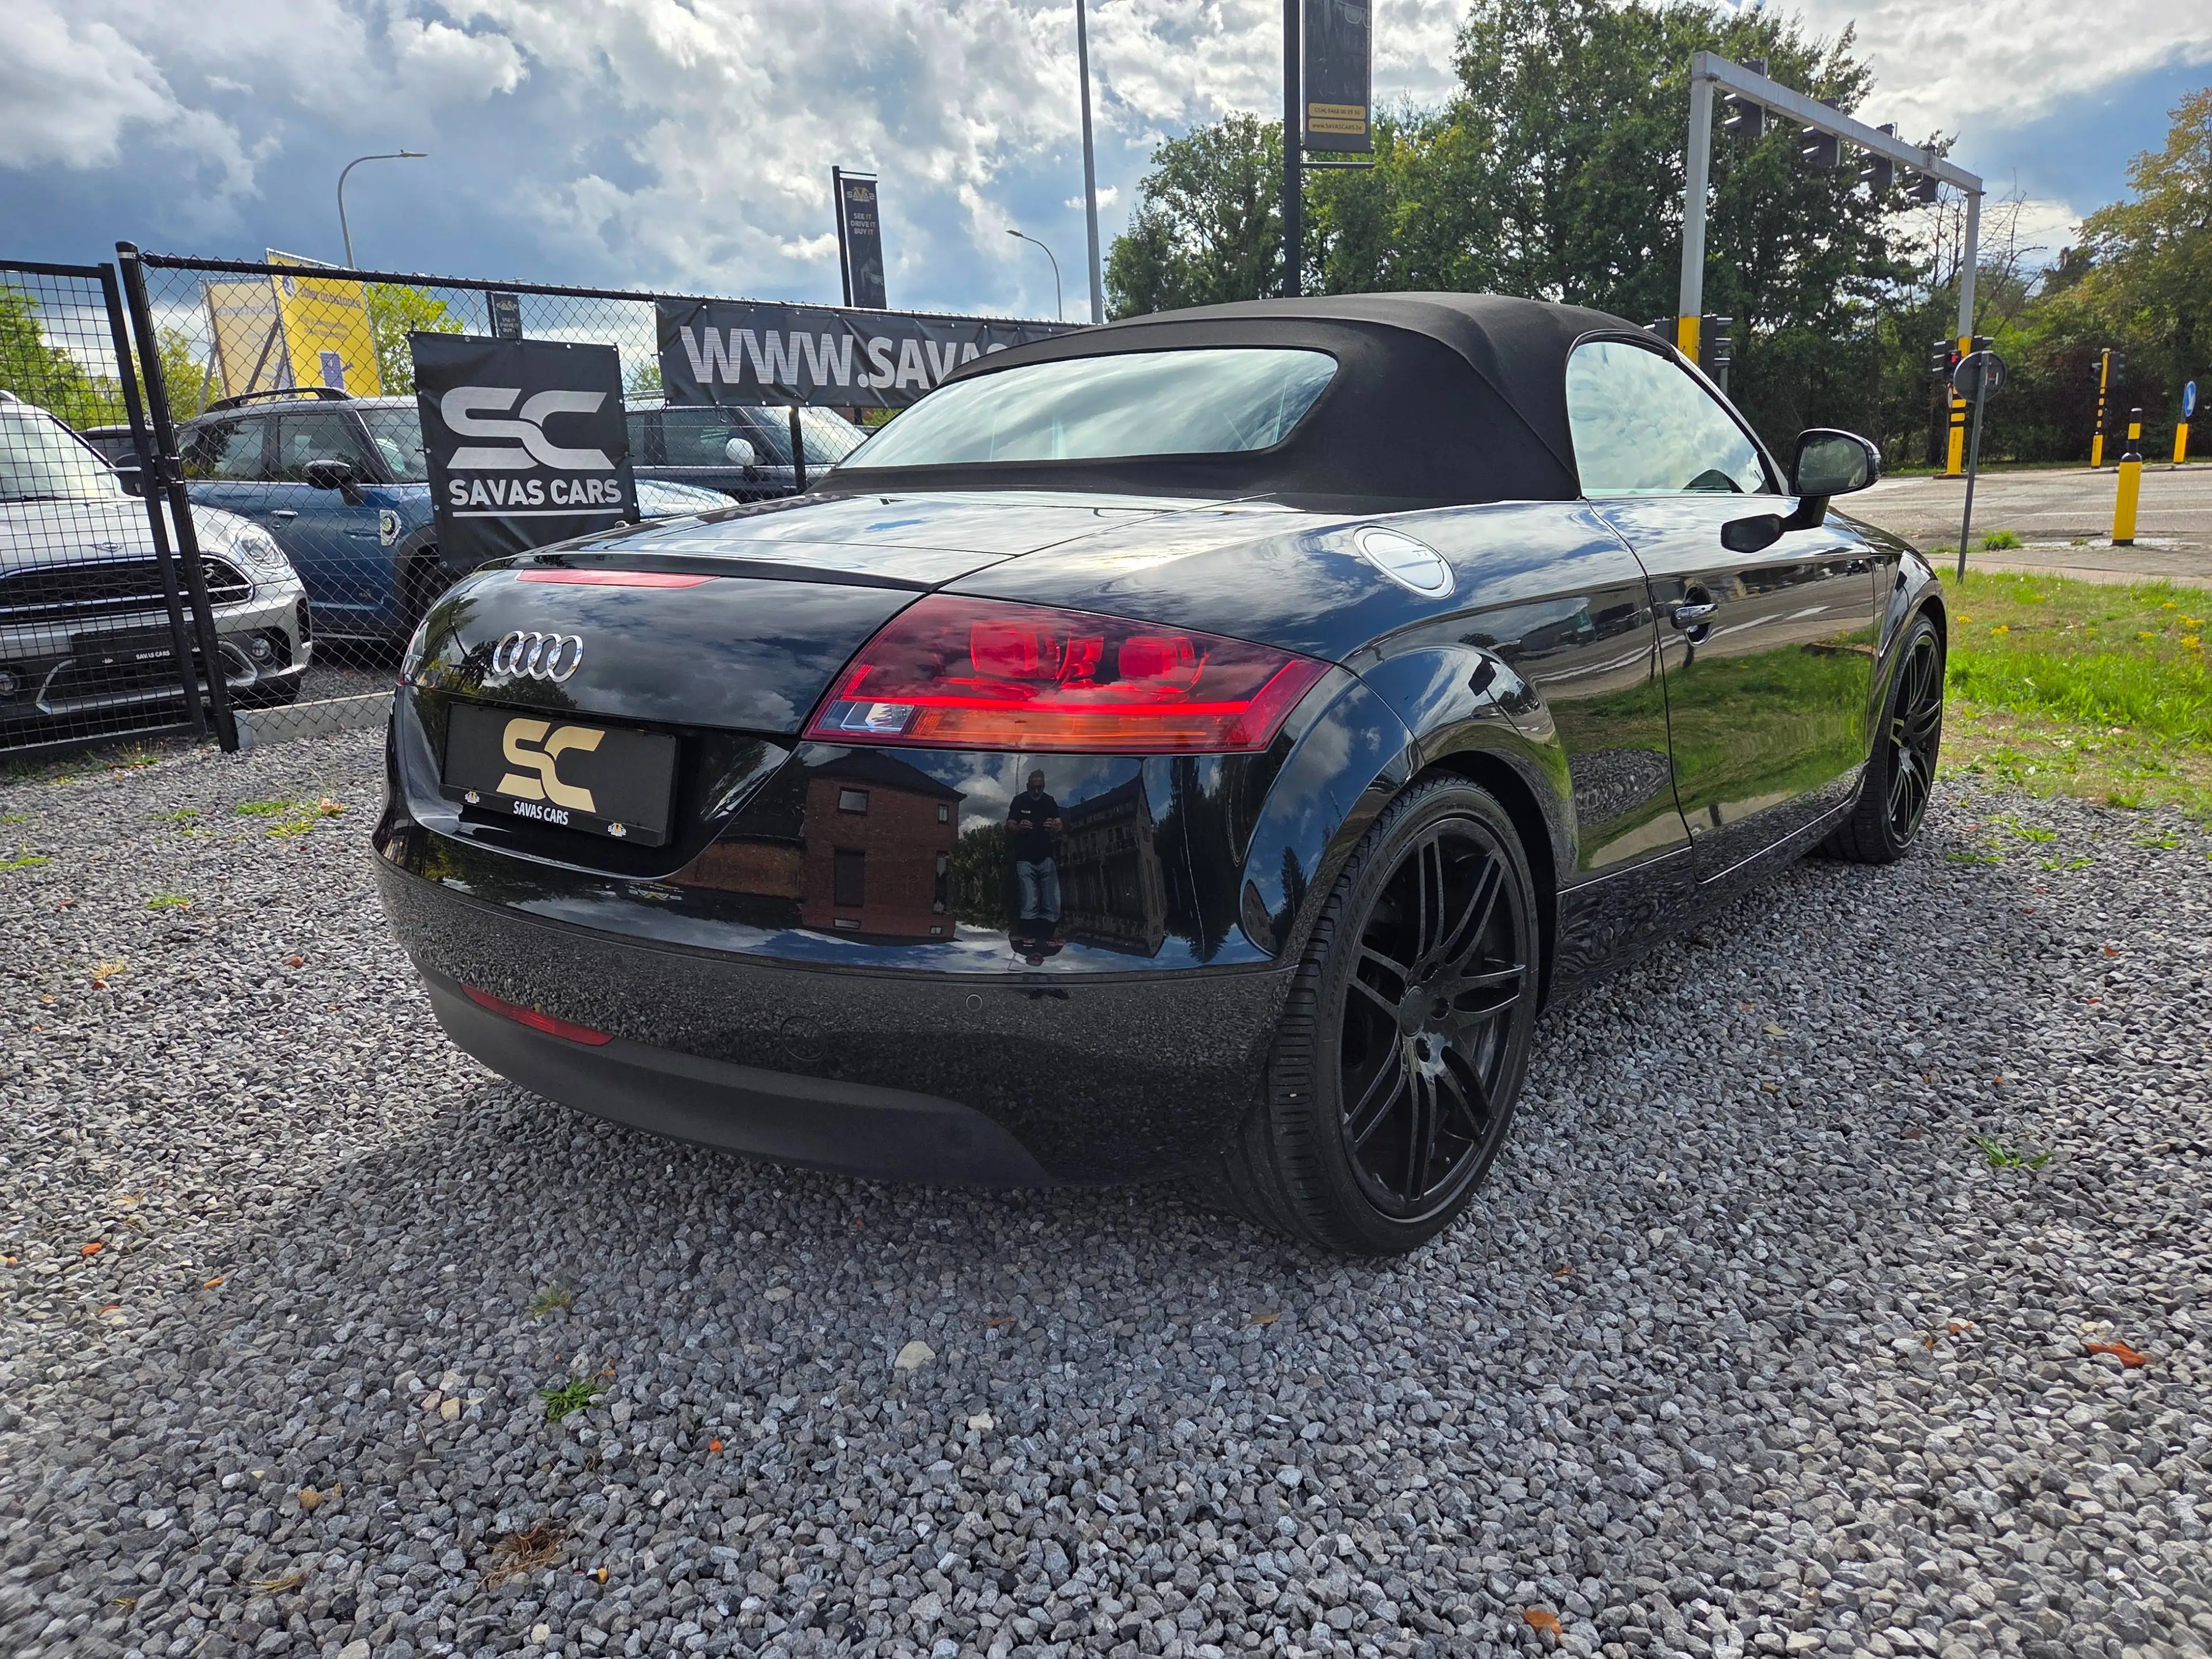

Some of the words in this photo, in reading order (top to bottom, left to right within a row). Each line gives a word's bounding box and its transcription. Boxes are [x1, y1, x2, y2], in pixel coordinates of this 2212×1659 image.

[680, 325, 1009, 389] WWW.SAV
[441, 387, 616, 469] SC
[449, 479, 545, 505] SAVAS
[550, 479, 622, 505] CARS
[496, 718, 605, 813] SC
[513, 801, 543, 819] SAVAS
[543, 807, 569, 825] CARS
